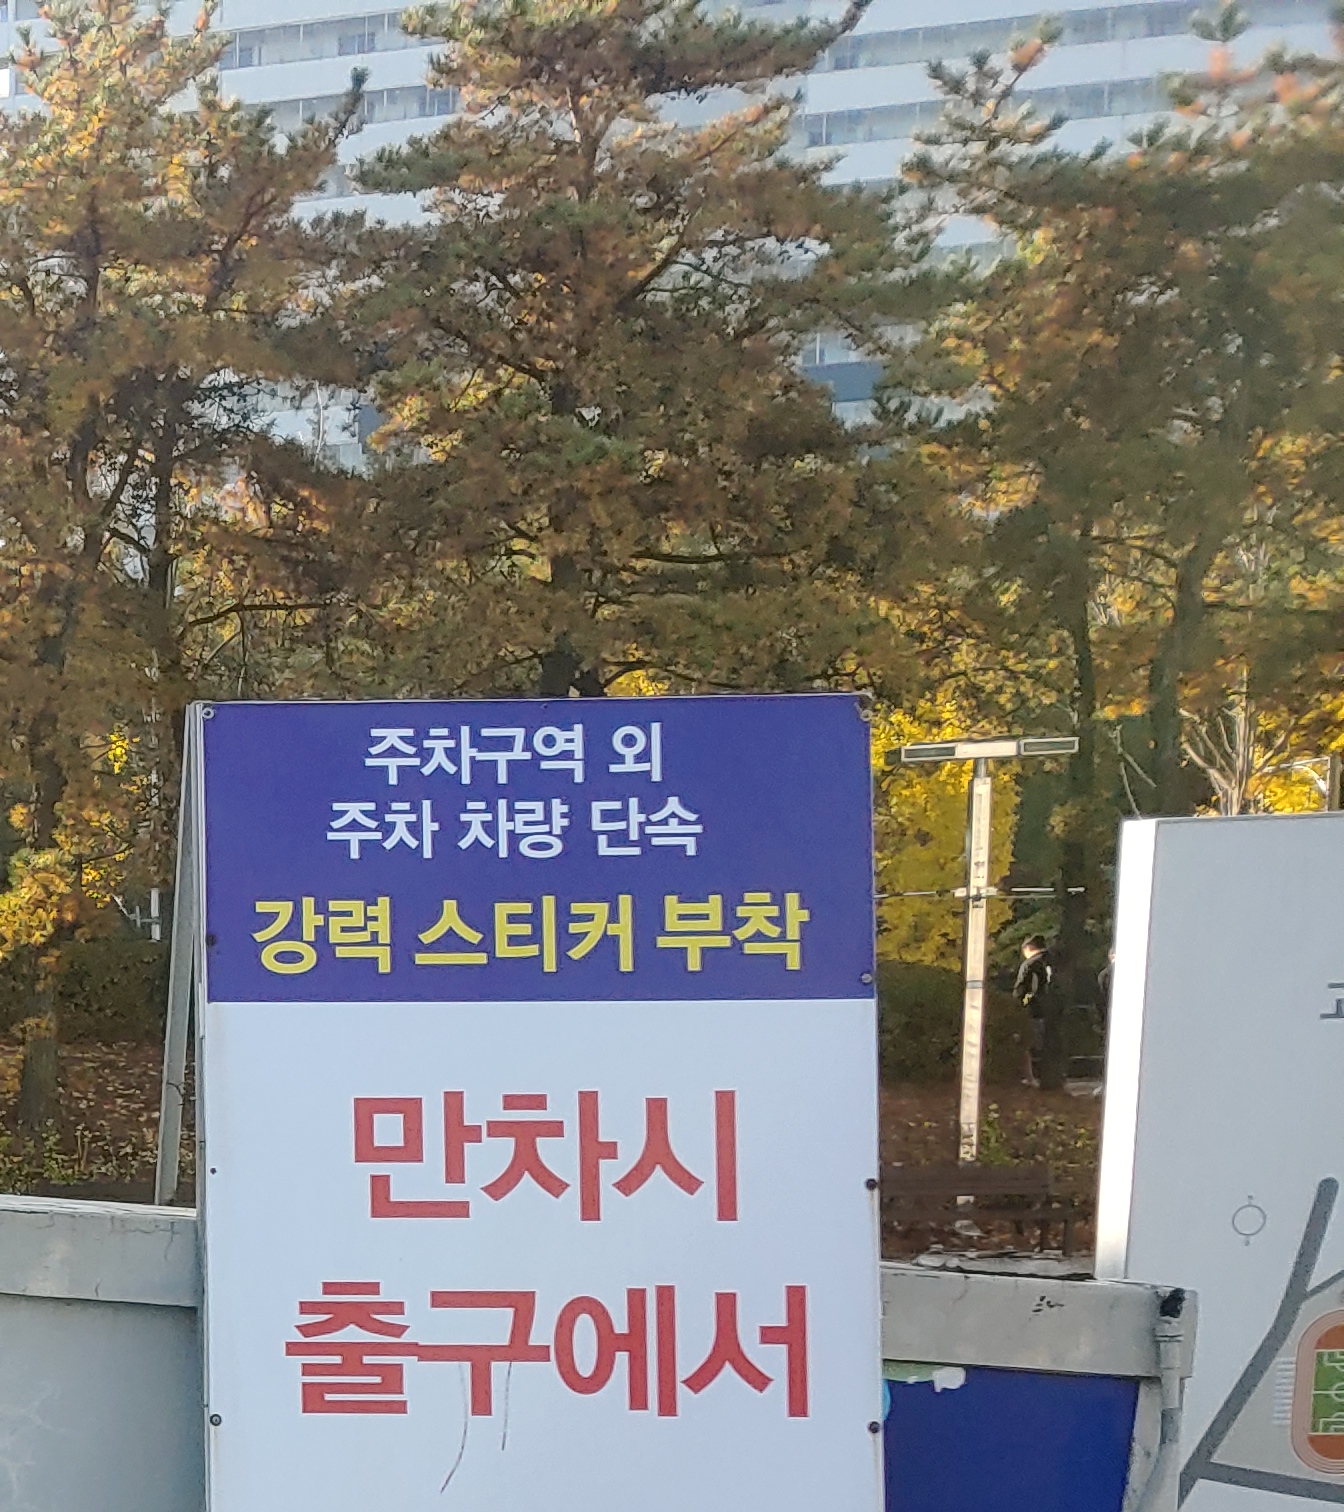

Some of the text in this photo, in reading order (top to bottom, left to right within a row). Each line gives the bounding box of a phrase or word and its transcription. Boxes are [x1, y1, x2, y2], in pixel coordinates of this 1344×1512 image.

[364, 721, 664, 785] 주차구역 외
[326, 796, 703, 860] 주차 차량 단속
[251, 892, 811, 975] 강력 스티커 부착
[353, 1090, 738, 1222] 만차시
[284, 1280, 809, 1418] 출구에서
